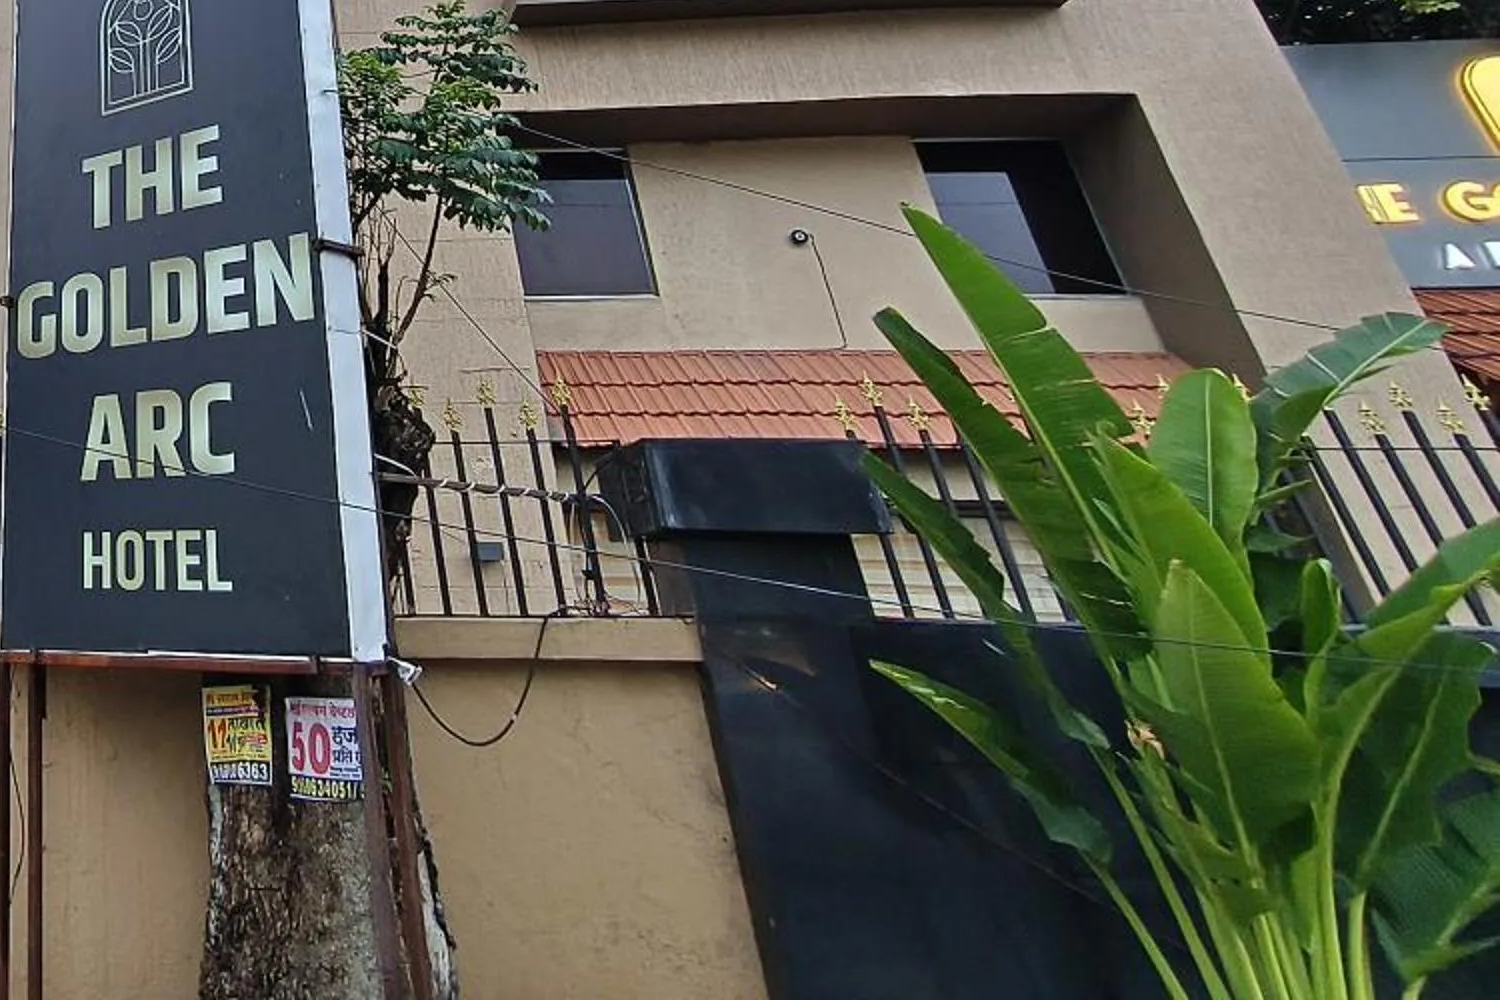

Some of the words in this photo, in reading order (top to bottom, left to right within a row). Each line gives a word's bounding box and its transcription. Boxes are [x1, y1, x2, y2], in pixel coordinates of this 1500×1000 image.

[81, 124, 223, 230] THE
[16, 232, 316, 359] GOLDEN
[80, 381, 235, 481] ARC
[82, 529, 233, 591] HOTEL
[291, 722, 331, 775] 50
